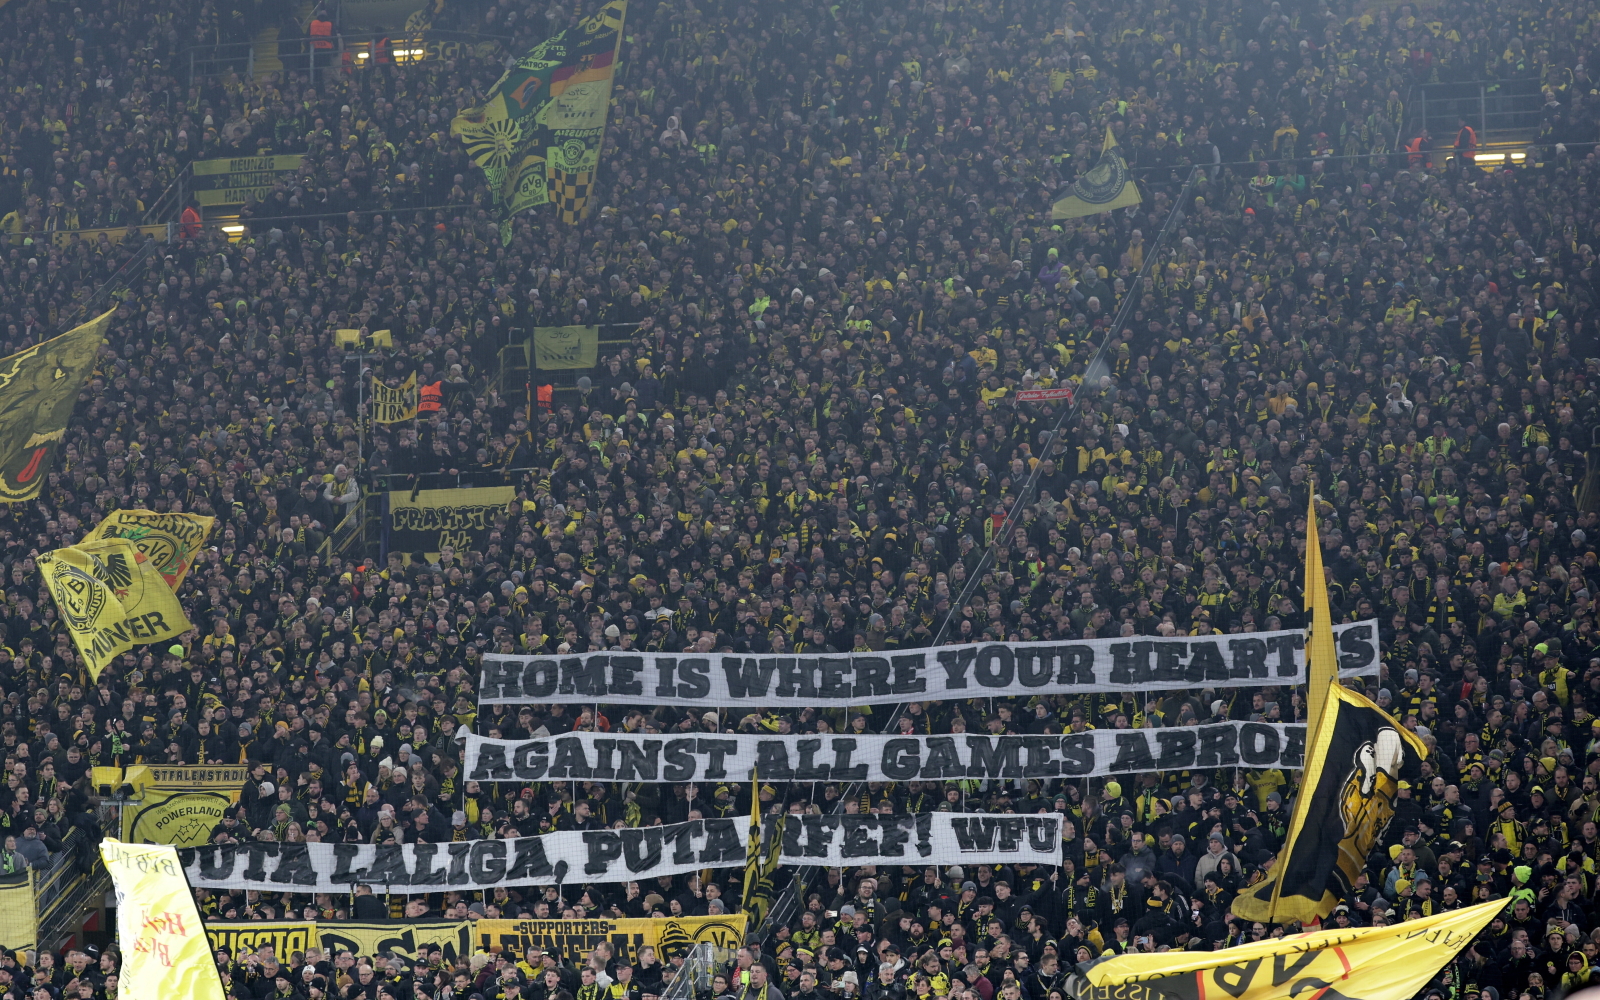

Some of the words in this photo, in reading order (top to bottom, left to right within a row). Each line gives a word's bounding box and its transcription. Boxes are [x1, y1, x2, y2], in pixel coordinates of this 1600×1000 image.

[230, 158, 275, 171] NEUNZIG
[229, 173, 276, 187] MINUTEN
[480, 655, 643, 699] HOME
[655, 657, 711, 698] IS
[722, 653, 927, 698] WHERE
[937, 645, 1096, 689] YOUR
[1110, 633, 1304, 684] HEART
[470, 736, 738, 781] AGAINST
[748, 738, 869, 780] ALL
[881, 734, 1095, 780] GAMES
[1109, 724, 1306, 772] ABROA
[155, 806, 222, 830] POWERLAND
[583, 819, 747, 875] PUTA
[951, 817, 1059, 853] WFU
[519, 921, 609, 935] SUPPORTERS
